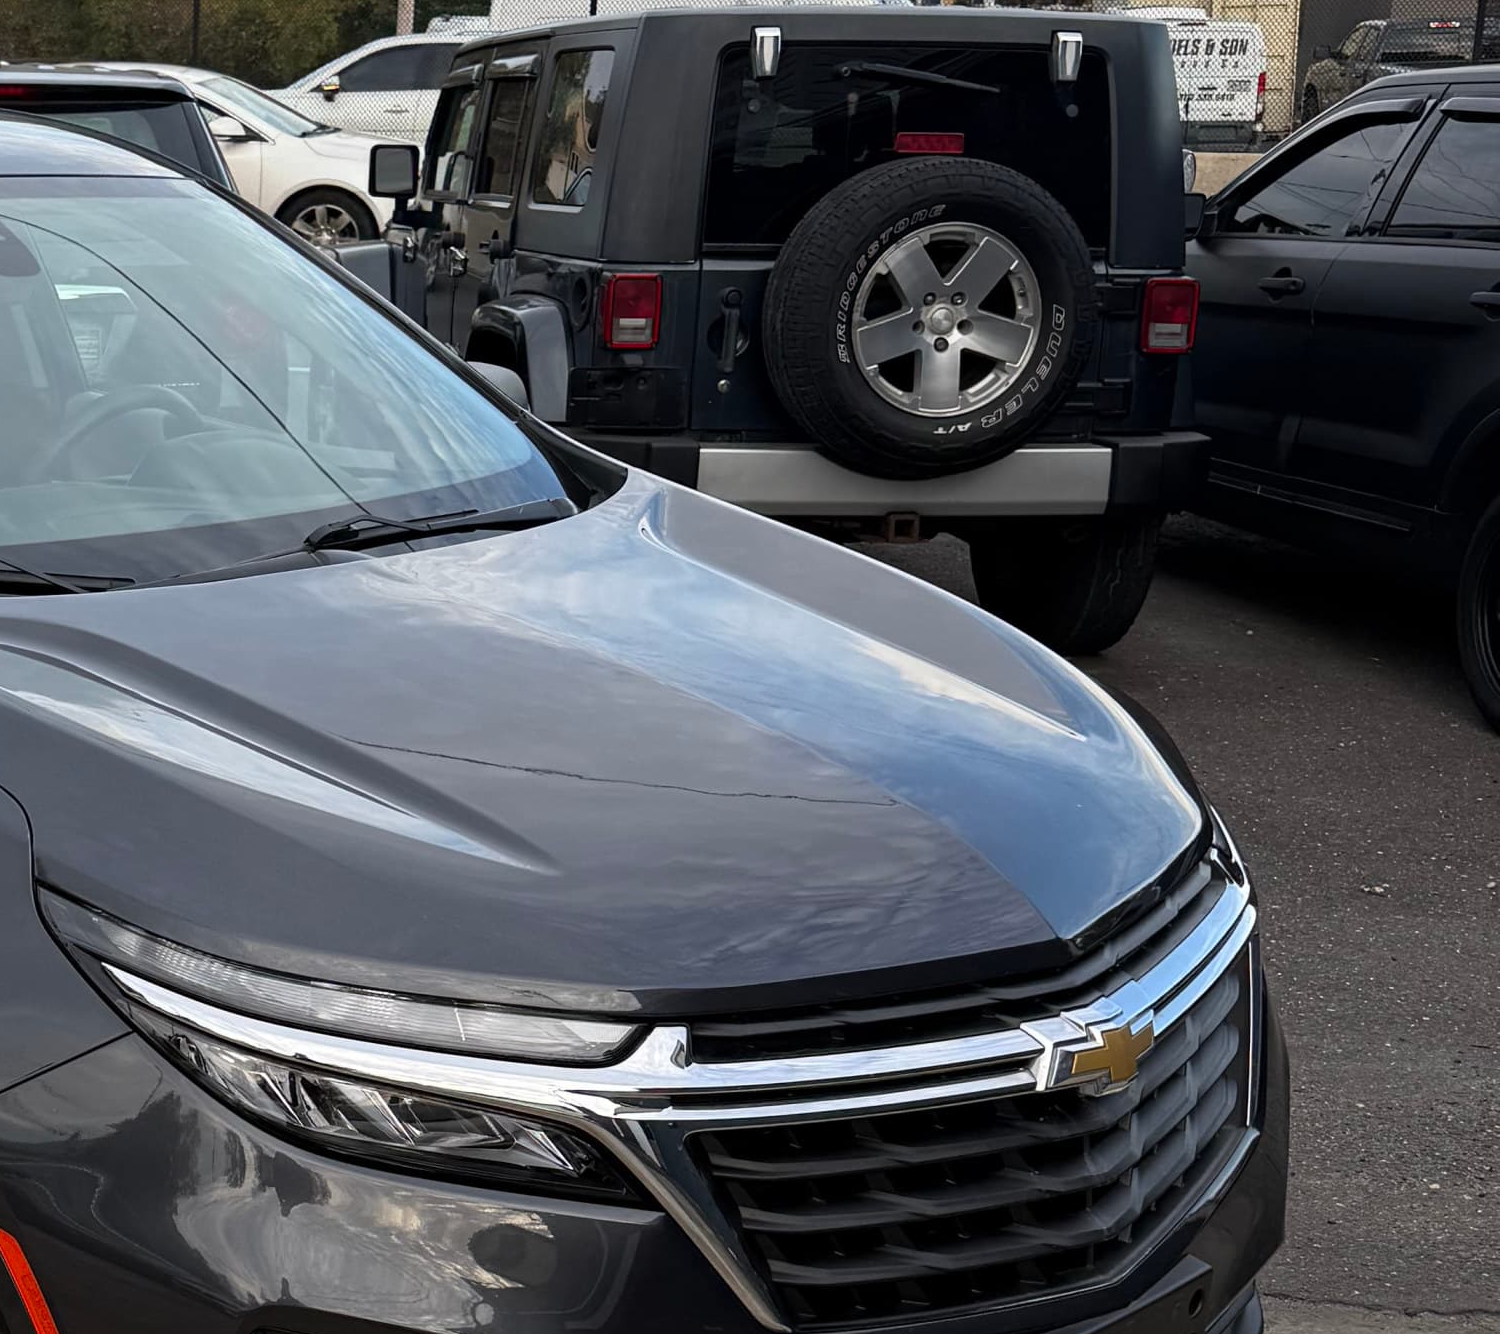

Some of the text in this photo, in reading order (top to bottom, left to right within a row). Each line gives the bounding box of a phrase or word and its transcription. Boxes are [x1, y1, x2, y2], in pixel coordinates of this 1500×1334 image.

[1219, 38, 1250, 56] SON
[836, 204, 947, 364] BRIDGESTONE
[980, 303, 1066, 429] DUELER
